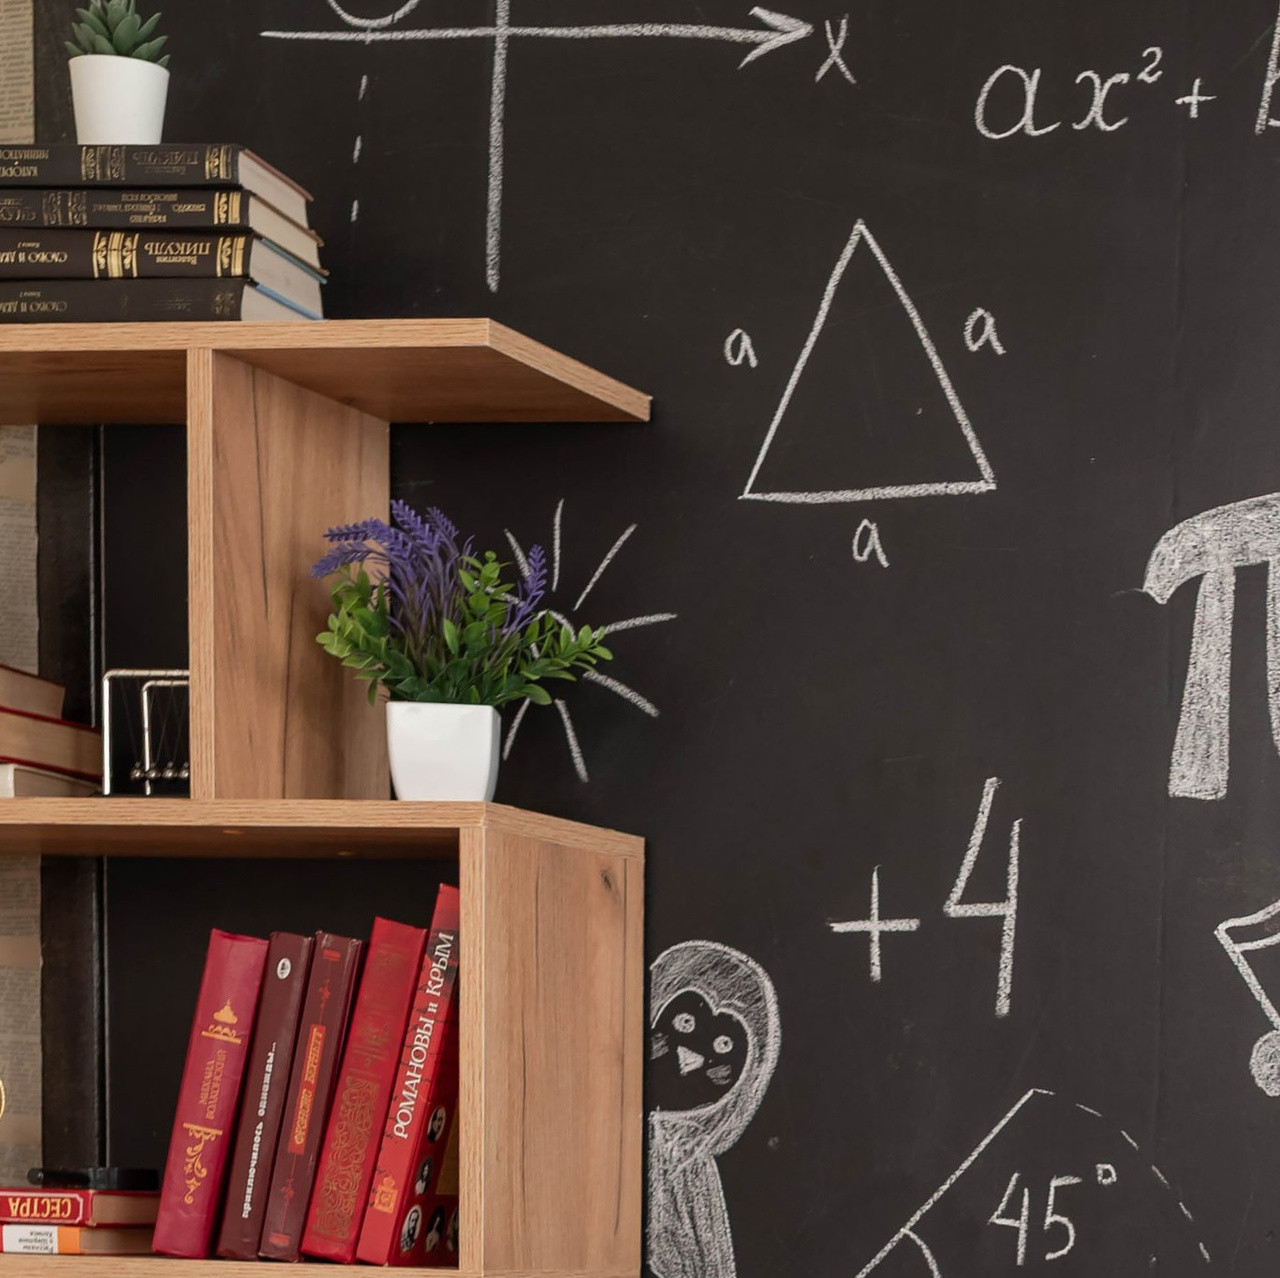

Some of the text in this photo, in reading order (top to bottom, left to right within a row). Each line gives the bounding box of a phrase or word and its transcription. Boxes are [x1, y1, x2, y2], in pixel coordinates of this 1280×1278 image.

[144, 242, 211, 255] ПИКУЛЬ
[156, 255, 197, 265] Валентин
[393, 1016, 435, 1139] РОМАНОВЫ
[425, 933, 454, 998] КРЫМ
[8, 1197, 72, 1218] СЕСТРА
